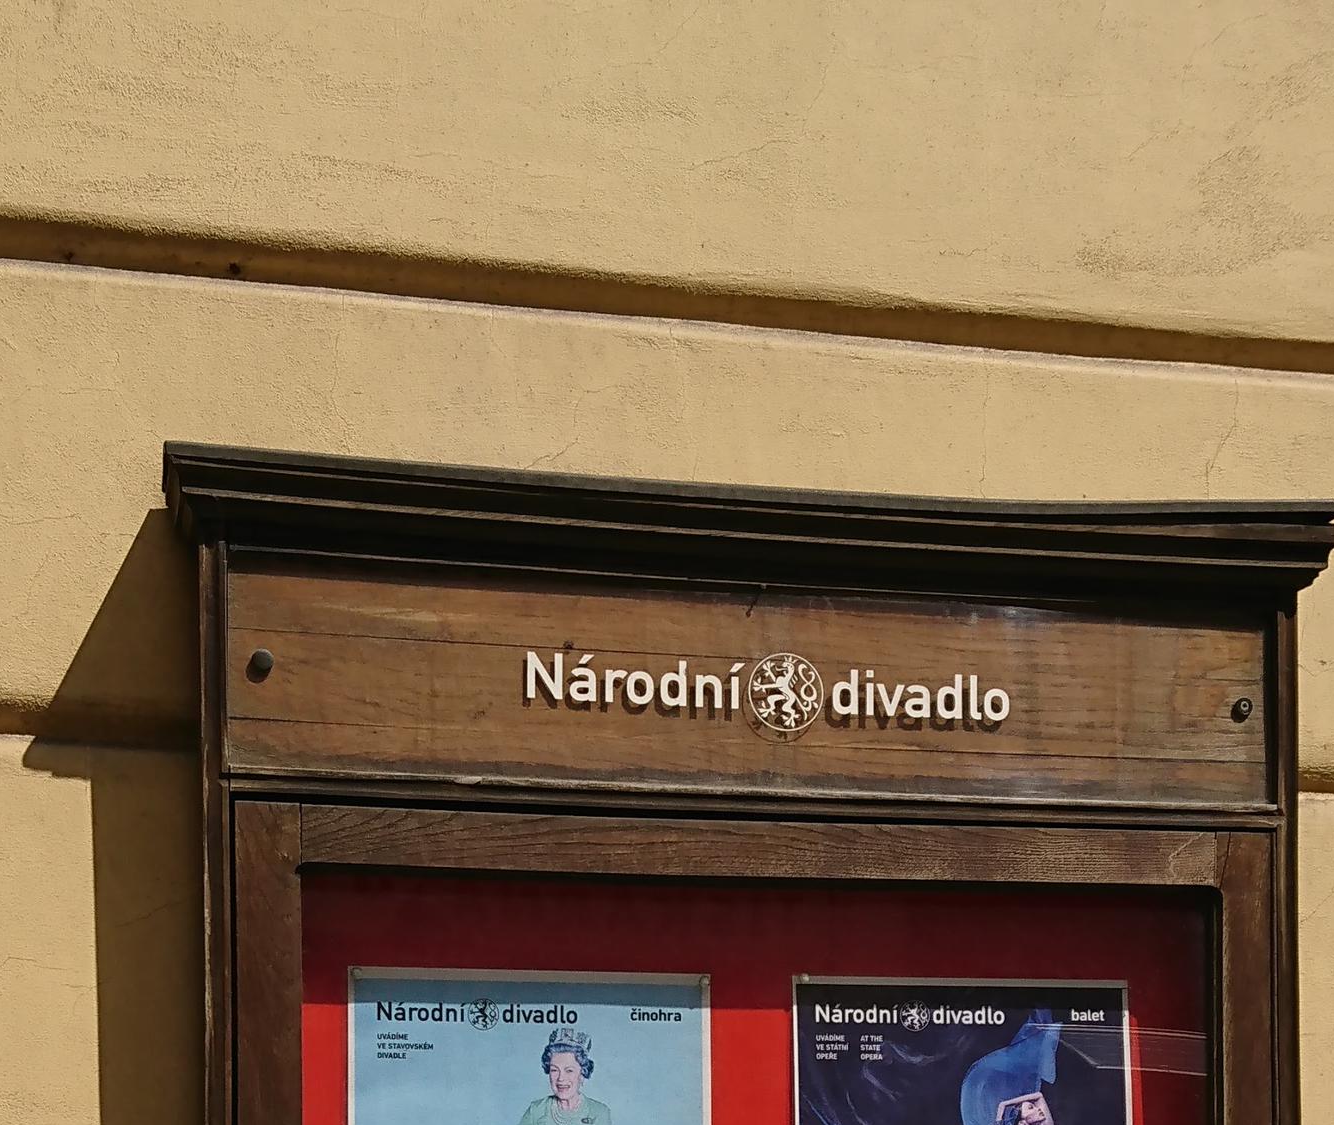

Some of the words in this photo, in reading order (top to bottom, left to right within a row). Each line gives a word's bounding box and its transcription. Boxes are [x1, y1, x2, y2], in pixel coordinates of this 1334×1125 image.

[526, 651, 745, 709] Národní
[832, 669, 1011, 720] divadlo
[377, 1000, 465, 1022] Národní
[502, 1003, 578, 1025] divadlo
[630, 1008, 682, 1022] činohra
[815, 1003, 898, 1024] Národní
[932, 1005, 1006, 1025] divadlo
[1071, 1009, 1105, 1022] balet
[377, 1031, 409, 1041] UVÁDÍME
[815, 1033, 845, 1042] UVÁDÍME
[377, 1042, 386, 1050] VE
[388, 1041, 434, 1051] STAVOVSKÉM
[816, 1043, 825, 1051] VE
[826, 1042, 849, 1051] STÁTNÍ
[377, 1052, 407, 1060] DIVADLE
[816, 1052, 838, 1060] OPEŘE
